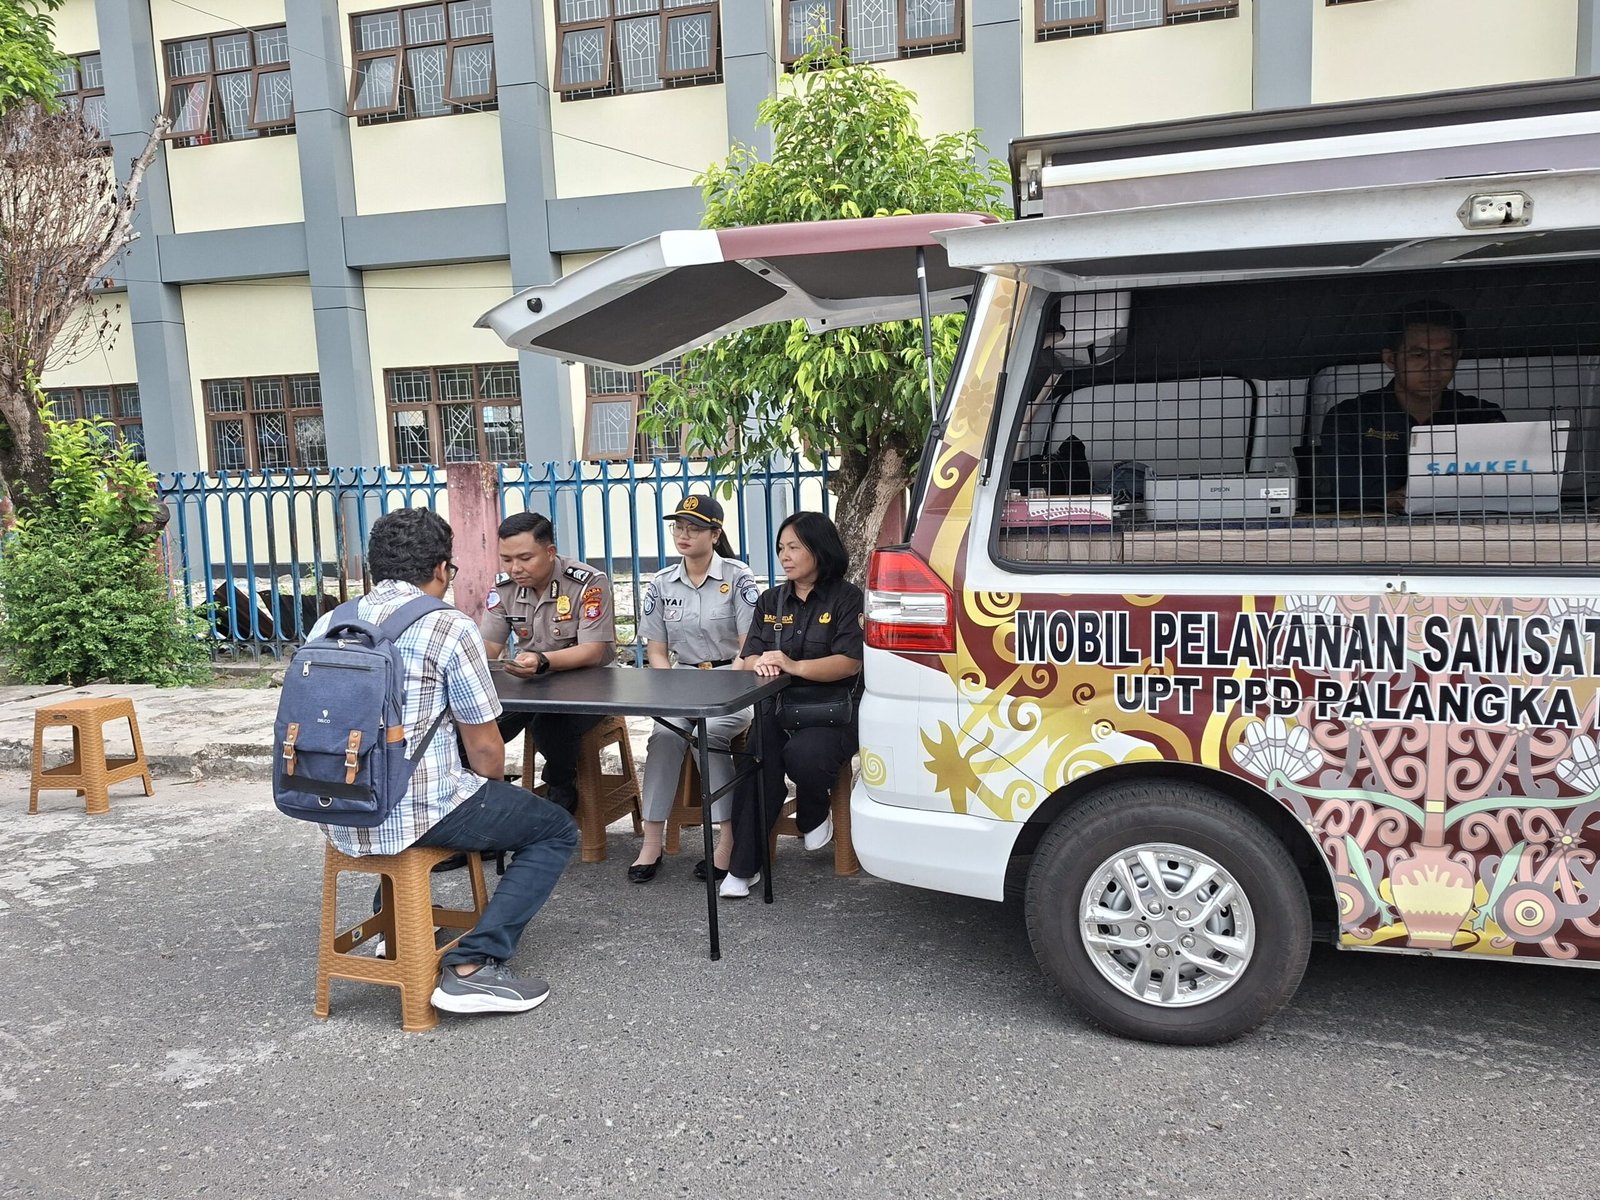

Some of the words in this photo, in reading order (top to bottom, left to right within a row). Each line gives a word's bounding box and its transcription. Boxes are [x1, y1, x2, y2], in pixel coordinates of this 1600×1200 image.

[1426, 460, 1535, 475] SAMKEL
[1015, 610, 1142, 665] MOBIL
[1150, 610, 1408, 672] PELAYANAN
[1421, 614, 1600, 677] SAMSAT
[1114, 674, 1202, 714] UPT
[1213, 676, 1304, 717] PPD
[1315, 679, 1581, 729] PALANGKA
